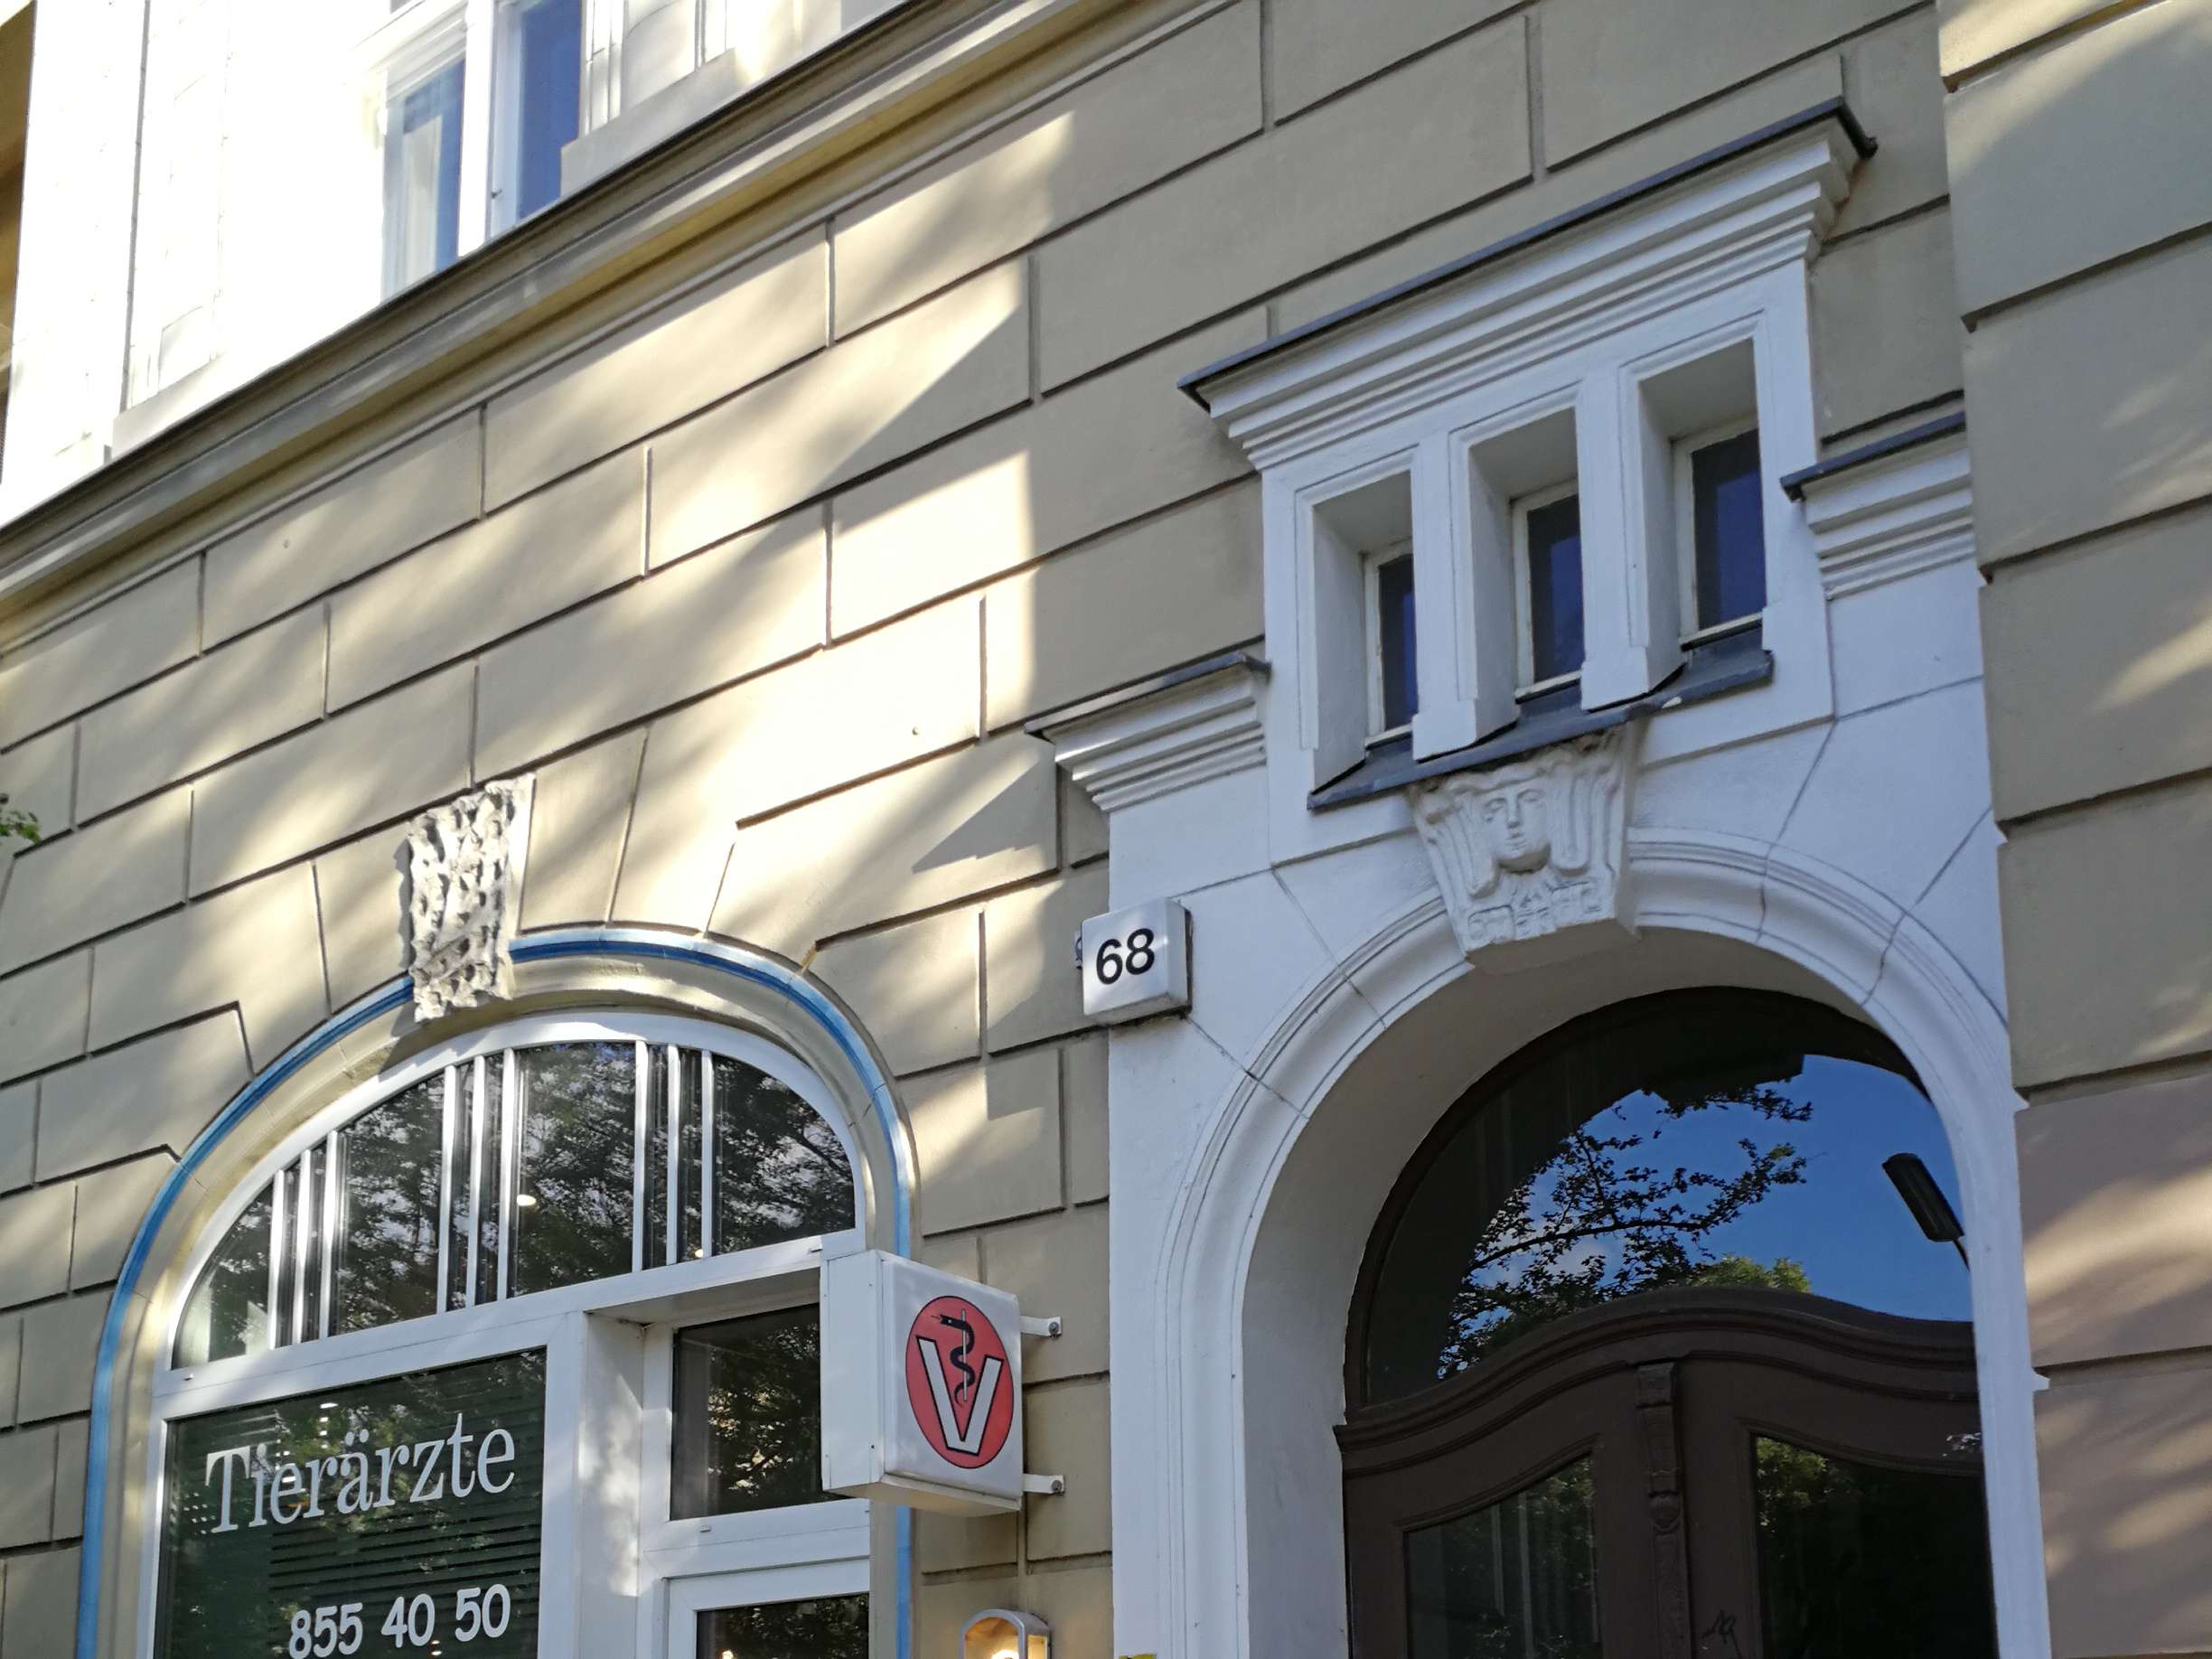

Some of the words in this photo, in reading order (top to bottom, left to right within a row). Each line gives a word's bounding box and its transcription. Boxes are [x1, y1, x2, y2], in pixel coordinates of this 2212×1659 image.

[1096, 928, 1155, 985] 68
[204, 1412, 515, 1533] Tierärzte
[289, 1602, 363, 1659] 855
[380, 1593, 436, 1648] 40
[455, 1583, 511, 1642] 50
